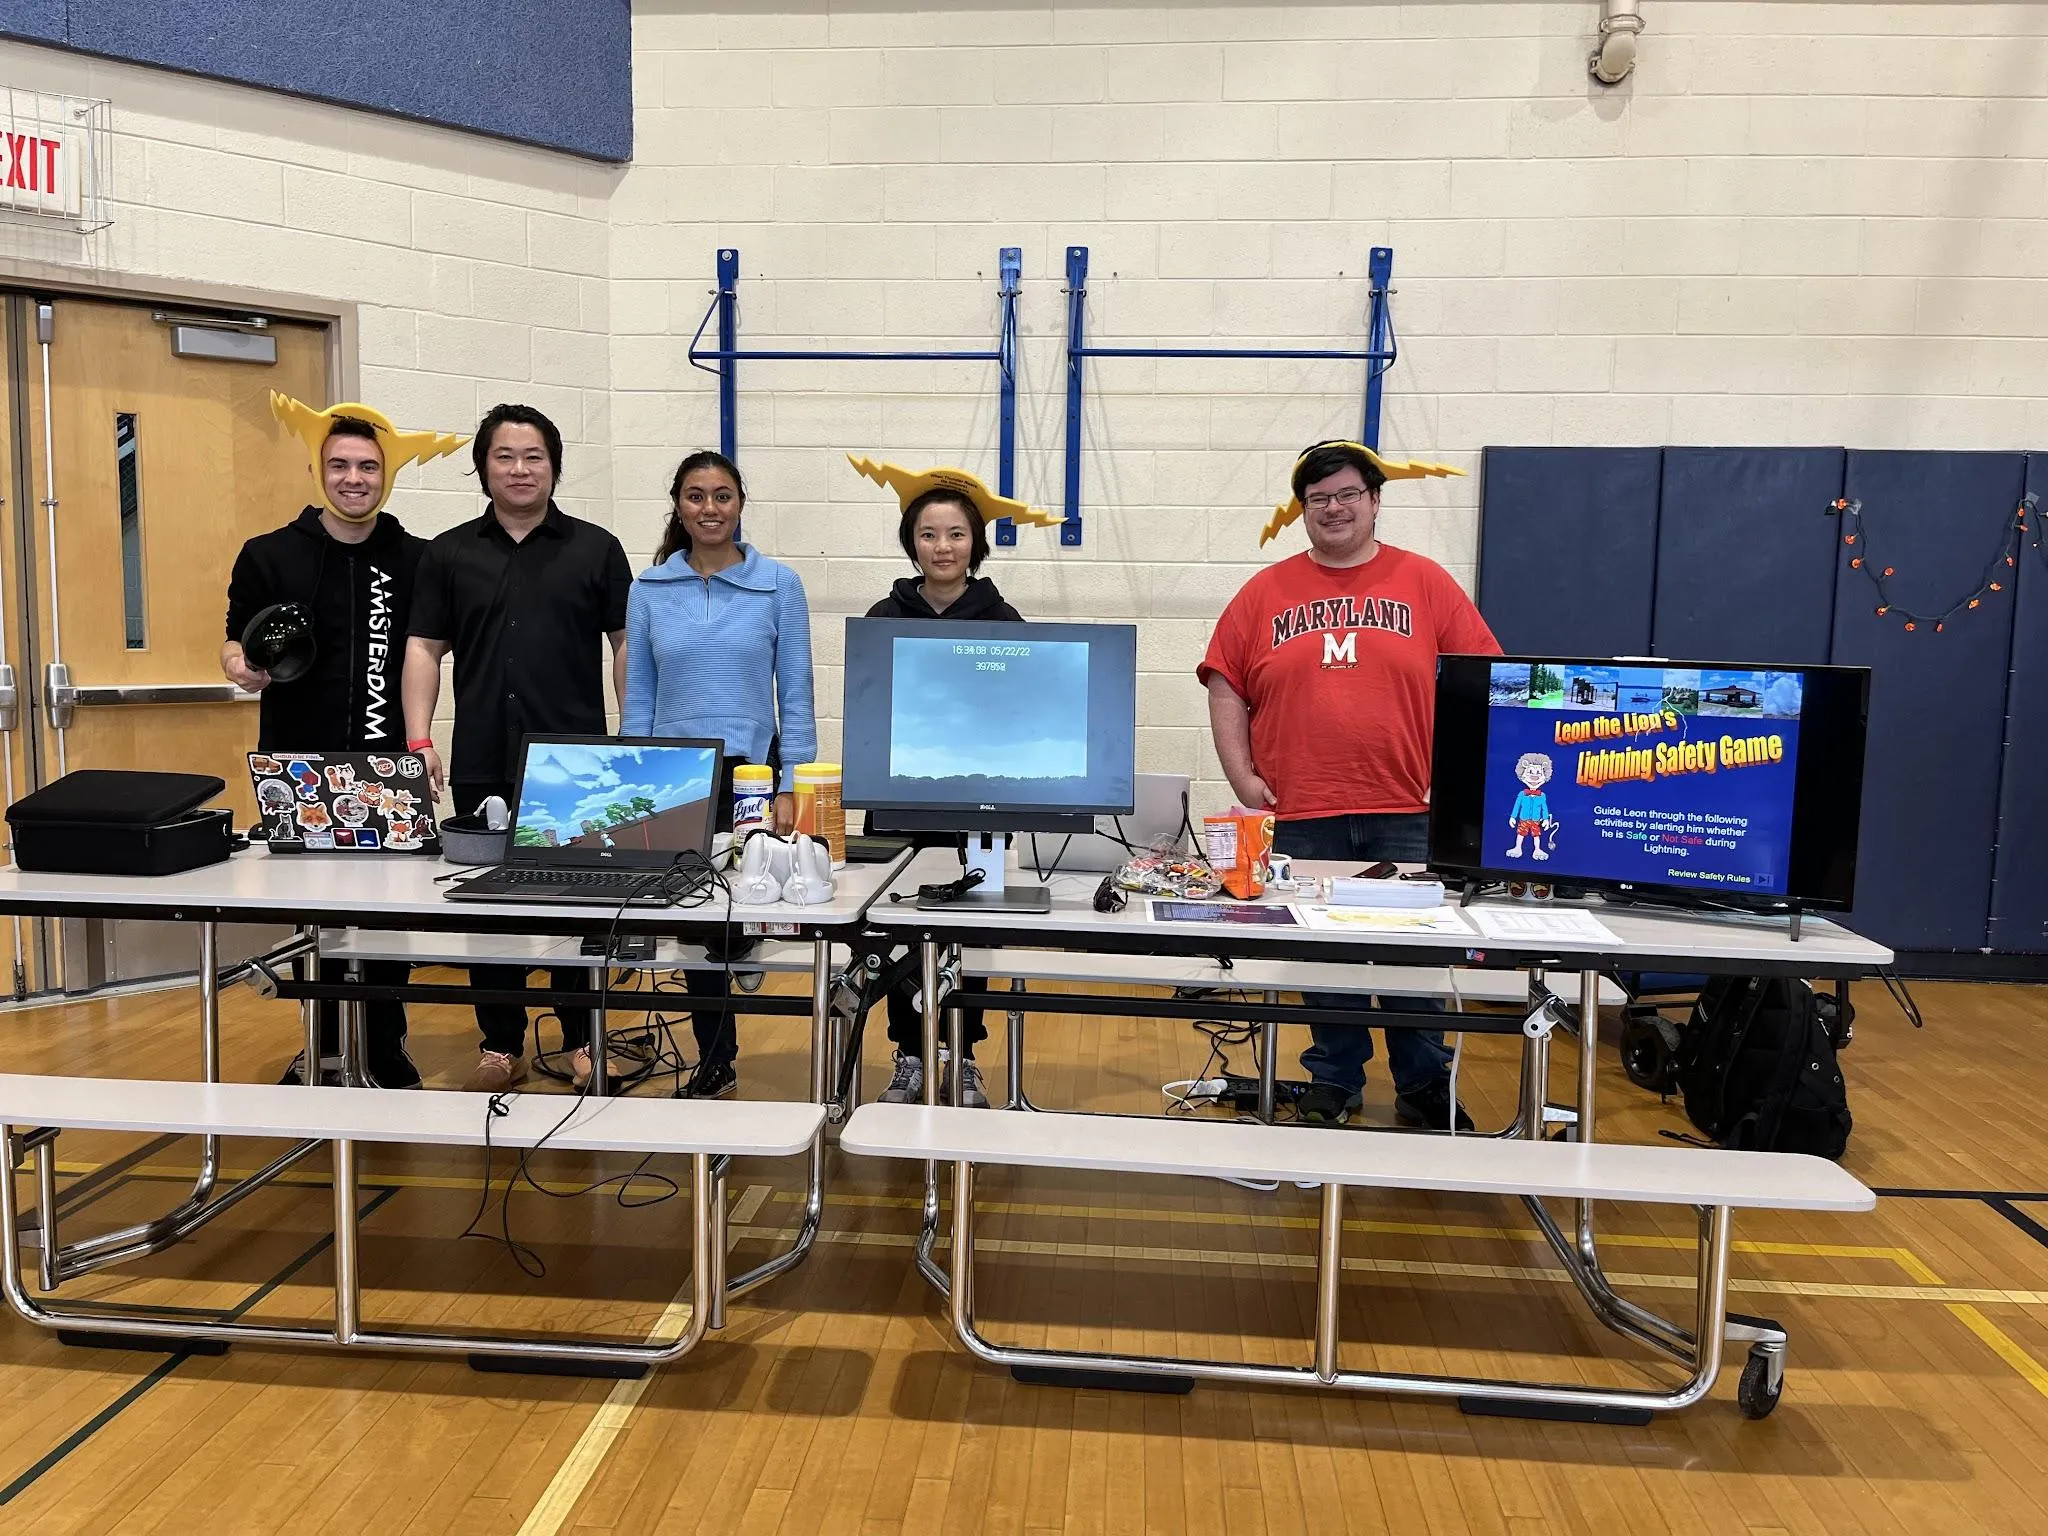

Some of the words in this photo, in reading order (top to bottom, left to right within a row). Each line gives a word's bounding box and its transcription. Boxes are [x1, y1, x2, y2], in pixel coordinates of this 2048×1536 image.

[0, 131, 60, 194] XIT
[1272, 596, 1413, 650] MARYLAND
[364, 565, 393, 740] AMSTERDAM
[990, 646, 1031, 657] 05/22/22
[1321, 632, 1358, 664] M
[1555, 719, 1590, 744] Leon
[1593, 716, 1621, 738] the
[1623, 709, 1678, 733] Lion's
[1576, 746, 1655, 788] Lightning
[1656, 740, 1716, 776] Safety
[1719, 734, 1784, 768] Game
[734, 798, 763, 819] Lysol
[1593, 806, 1621, 816] Guide
[1623, 808, 1647, 818] Leon
[1649, 810, 1685, 822] through
[1687, 812, 1702, 822] the
[1704, 813, 1748, 827] following
[1594, 817, 1634, 828] activities
[1635, 820, 1647, 831] by
[1649, 821, 1684, 833] alerting
[1686, 824, 1704, 834] him
[1706, 826, 1746, 837] whether
[1601, 828, 1613, 838] he
[1615, 829, 1624, 839] is
[1626, 830, 1648, 840] Safe
[1649, 834, 1660, 842] or
[1661, 833, 1679, 844] Not
[1681, 834, 1704, 845] Safe
[1705, 838, 1737, 849] during
[1644, 843, 1690, 857] Lightning.
[1668, 869, 1697, 879] Review
[1699, 871, 1725, 883] Safety
[1727, 874, 1751, 883] Rules
